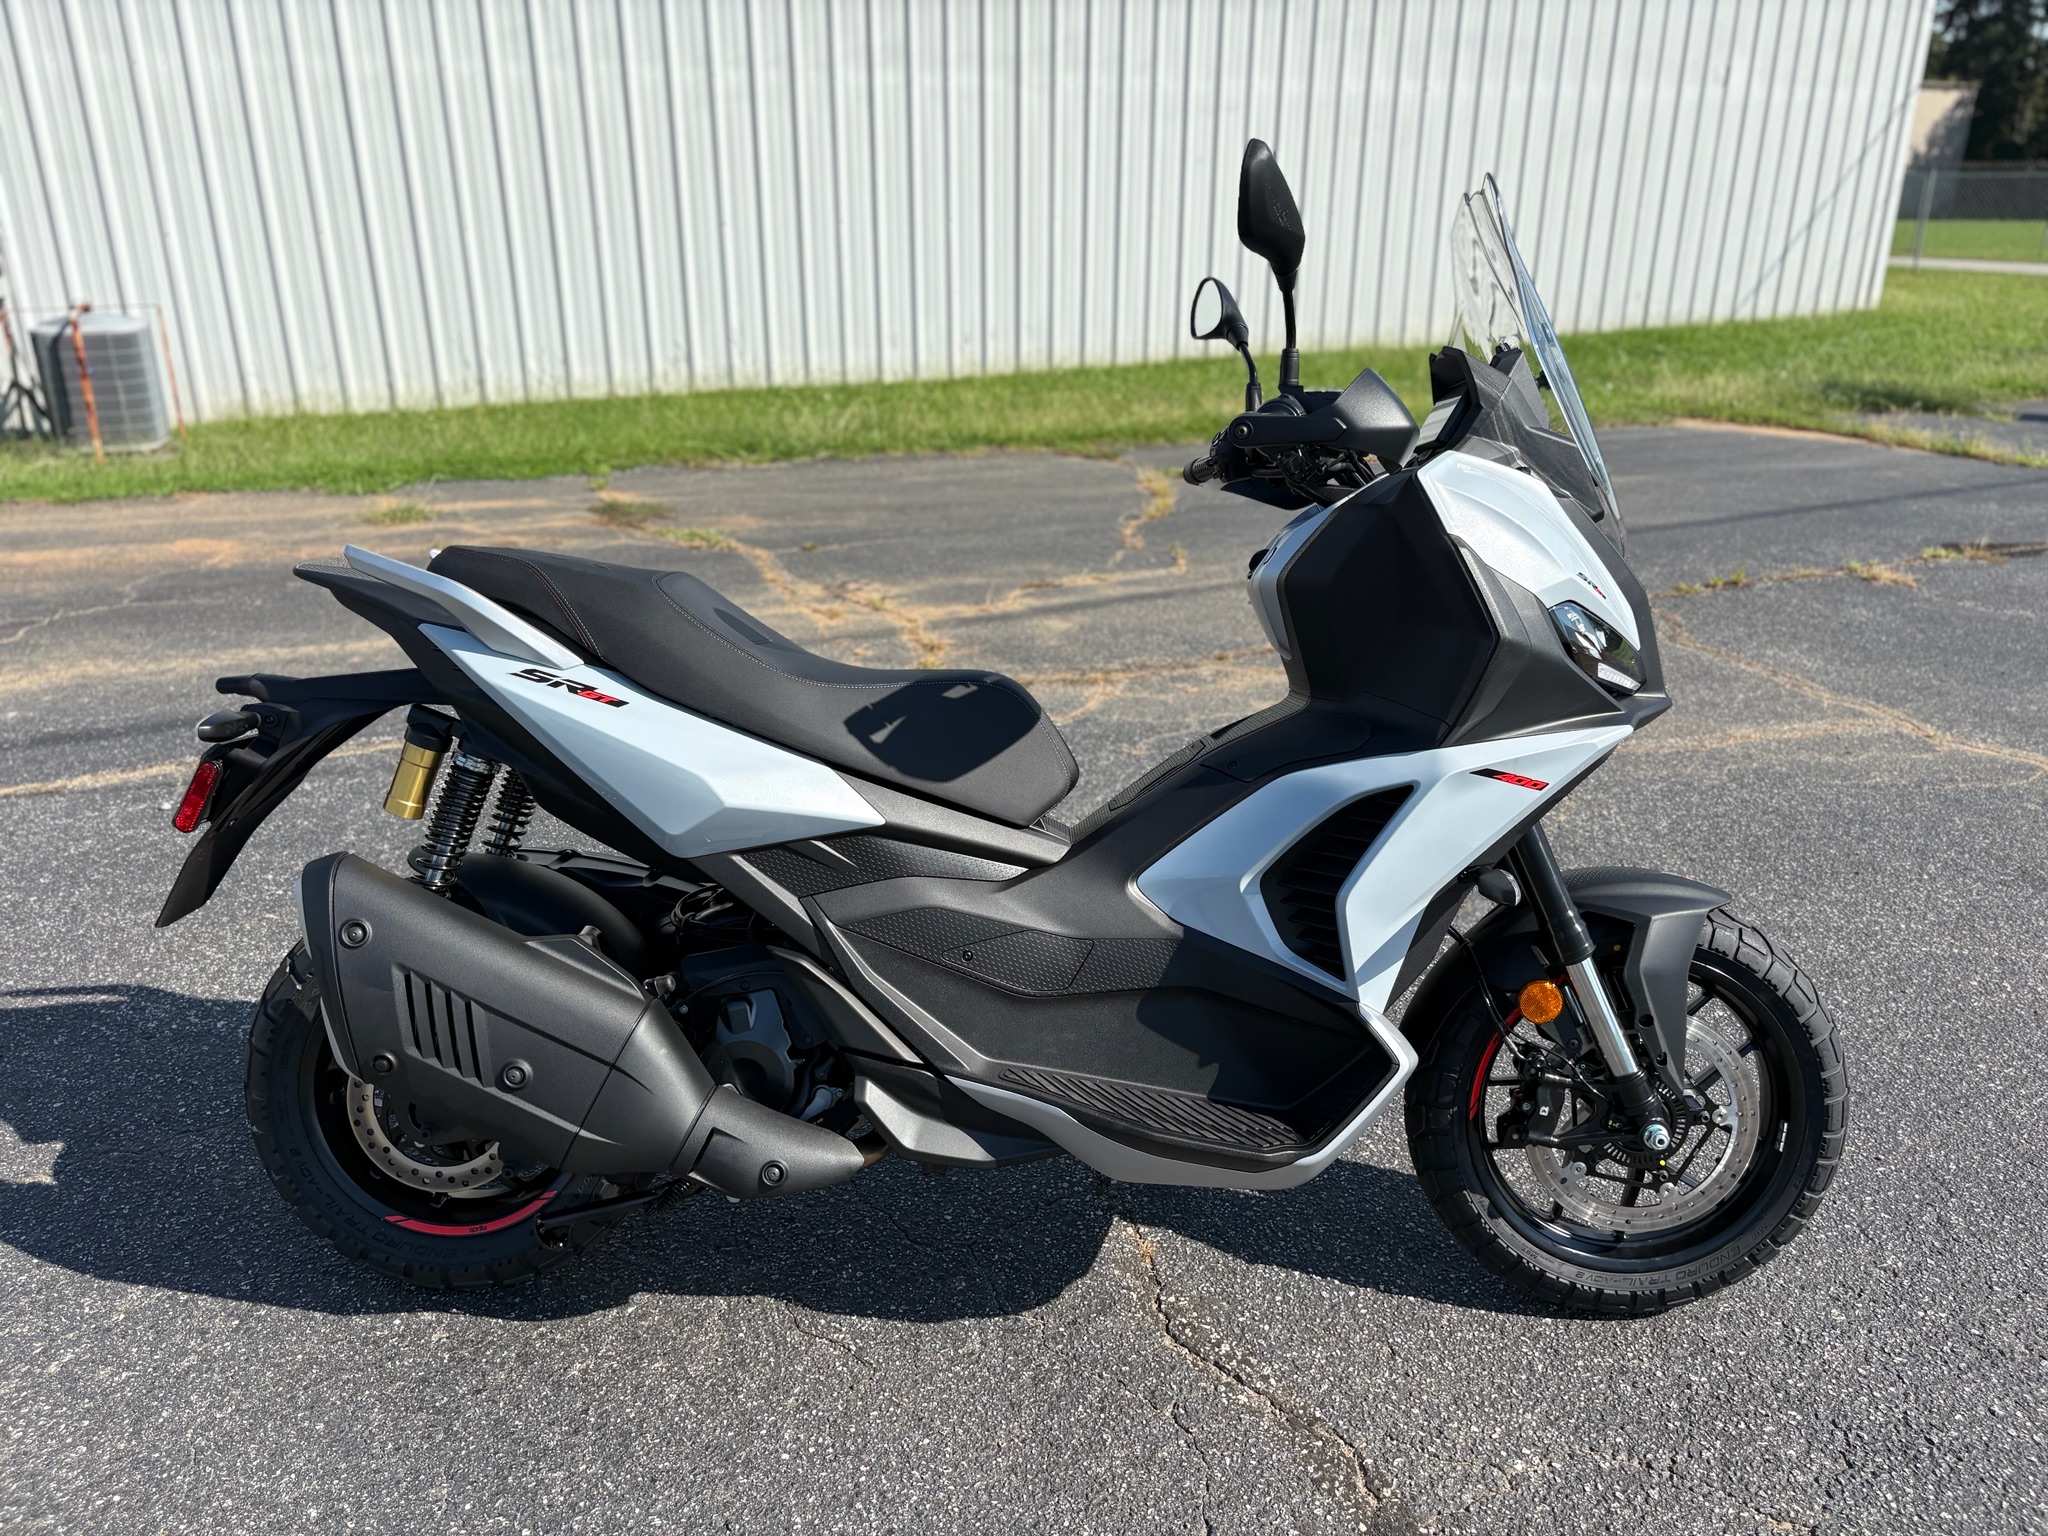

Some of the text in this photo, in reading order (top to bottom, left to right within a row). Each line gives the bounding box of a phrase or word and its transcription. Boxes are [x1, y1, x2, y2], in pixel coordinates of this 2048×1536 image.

[1491, 773, 1549, 791] 400
[468, 1225, 489, 1234] aprilia
[371, 1231, 458, 1258] ENDURO
[1675, 1244, 1741, 1279] ENDURO
